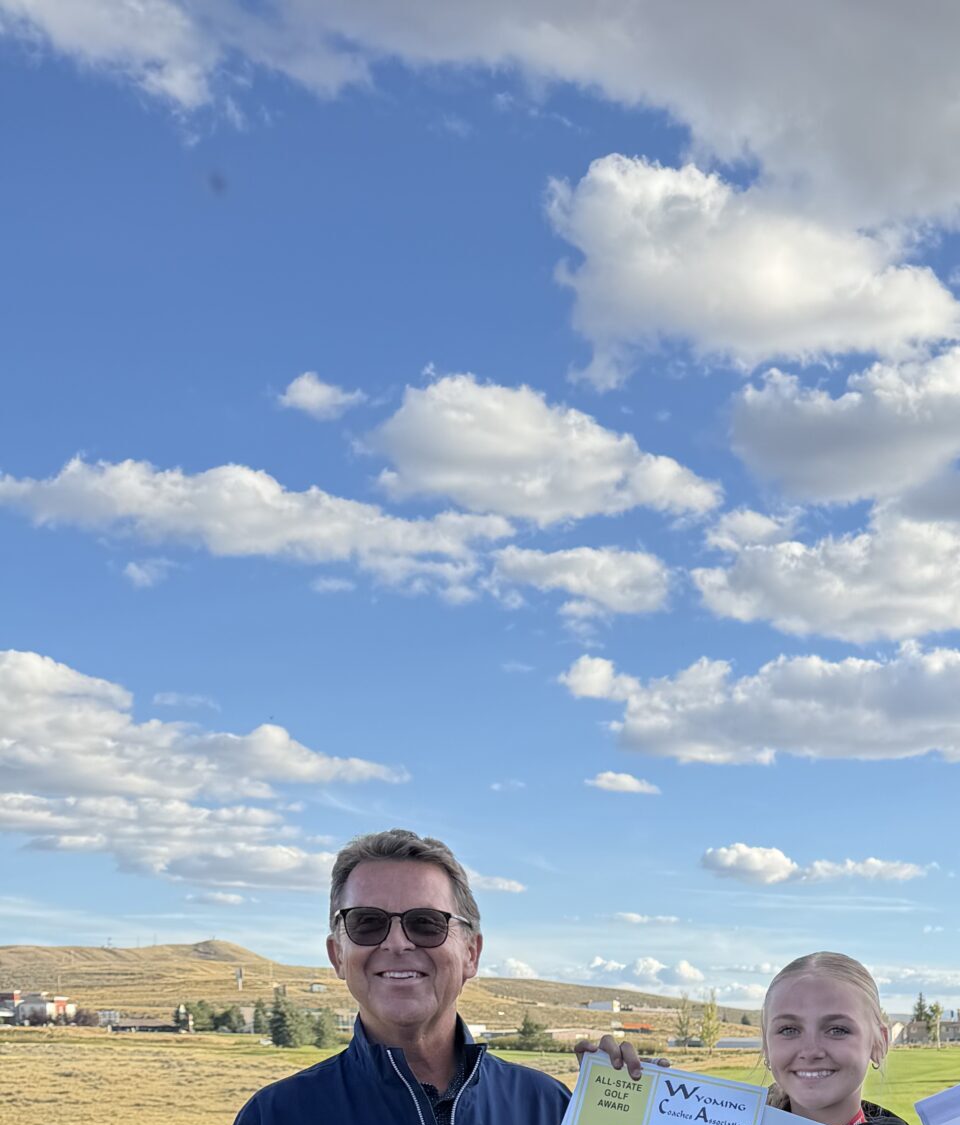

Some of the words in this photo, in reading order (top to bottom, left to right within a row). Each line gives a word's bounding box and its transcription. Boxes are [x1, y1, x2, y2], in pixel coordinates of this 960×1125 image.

[595, 1076, 643, 1092] ALL-STATE
[604, 1089, 629, 1100] GOLF
[664, 1080, 746, 1112] WYOMING
[597, 1100, 630, 1112] AWARD
[659, 1099, 693, 1120] Coaches
